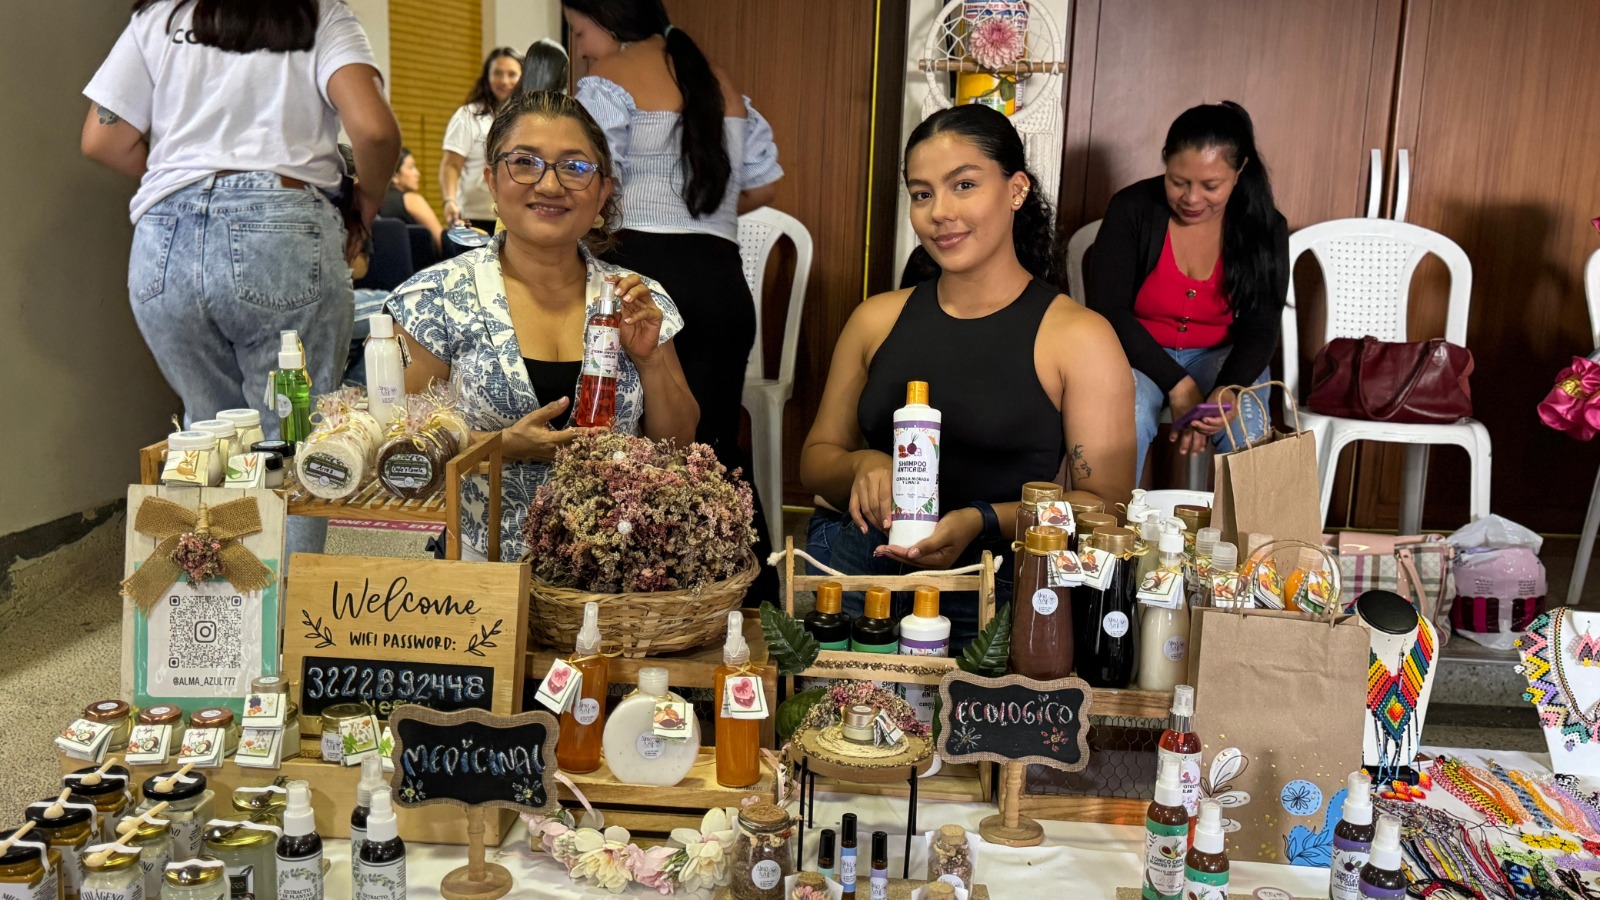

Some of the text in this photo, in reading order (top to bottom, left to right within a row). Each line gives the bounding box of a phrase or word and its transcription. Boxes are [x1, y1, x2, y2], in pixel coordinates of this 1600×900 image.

[332, 576, 482, 622] Welcome
[349, 631, 457, 651] WIFI PASSWORD:
[173, 676, 236, 686] @ALMA_AZUL777
[307, 665, 486, 702] 3222892448
